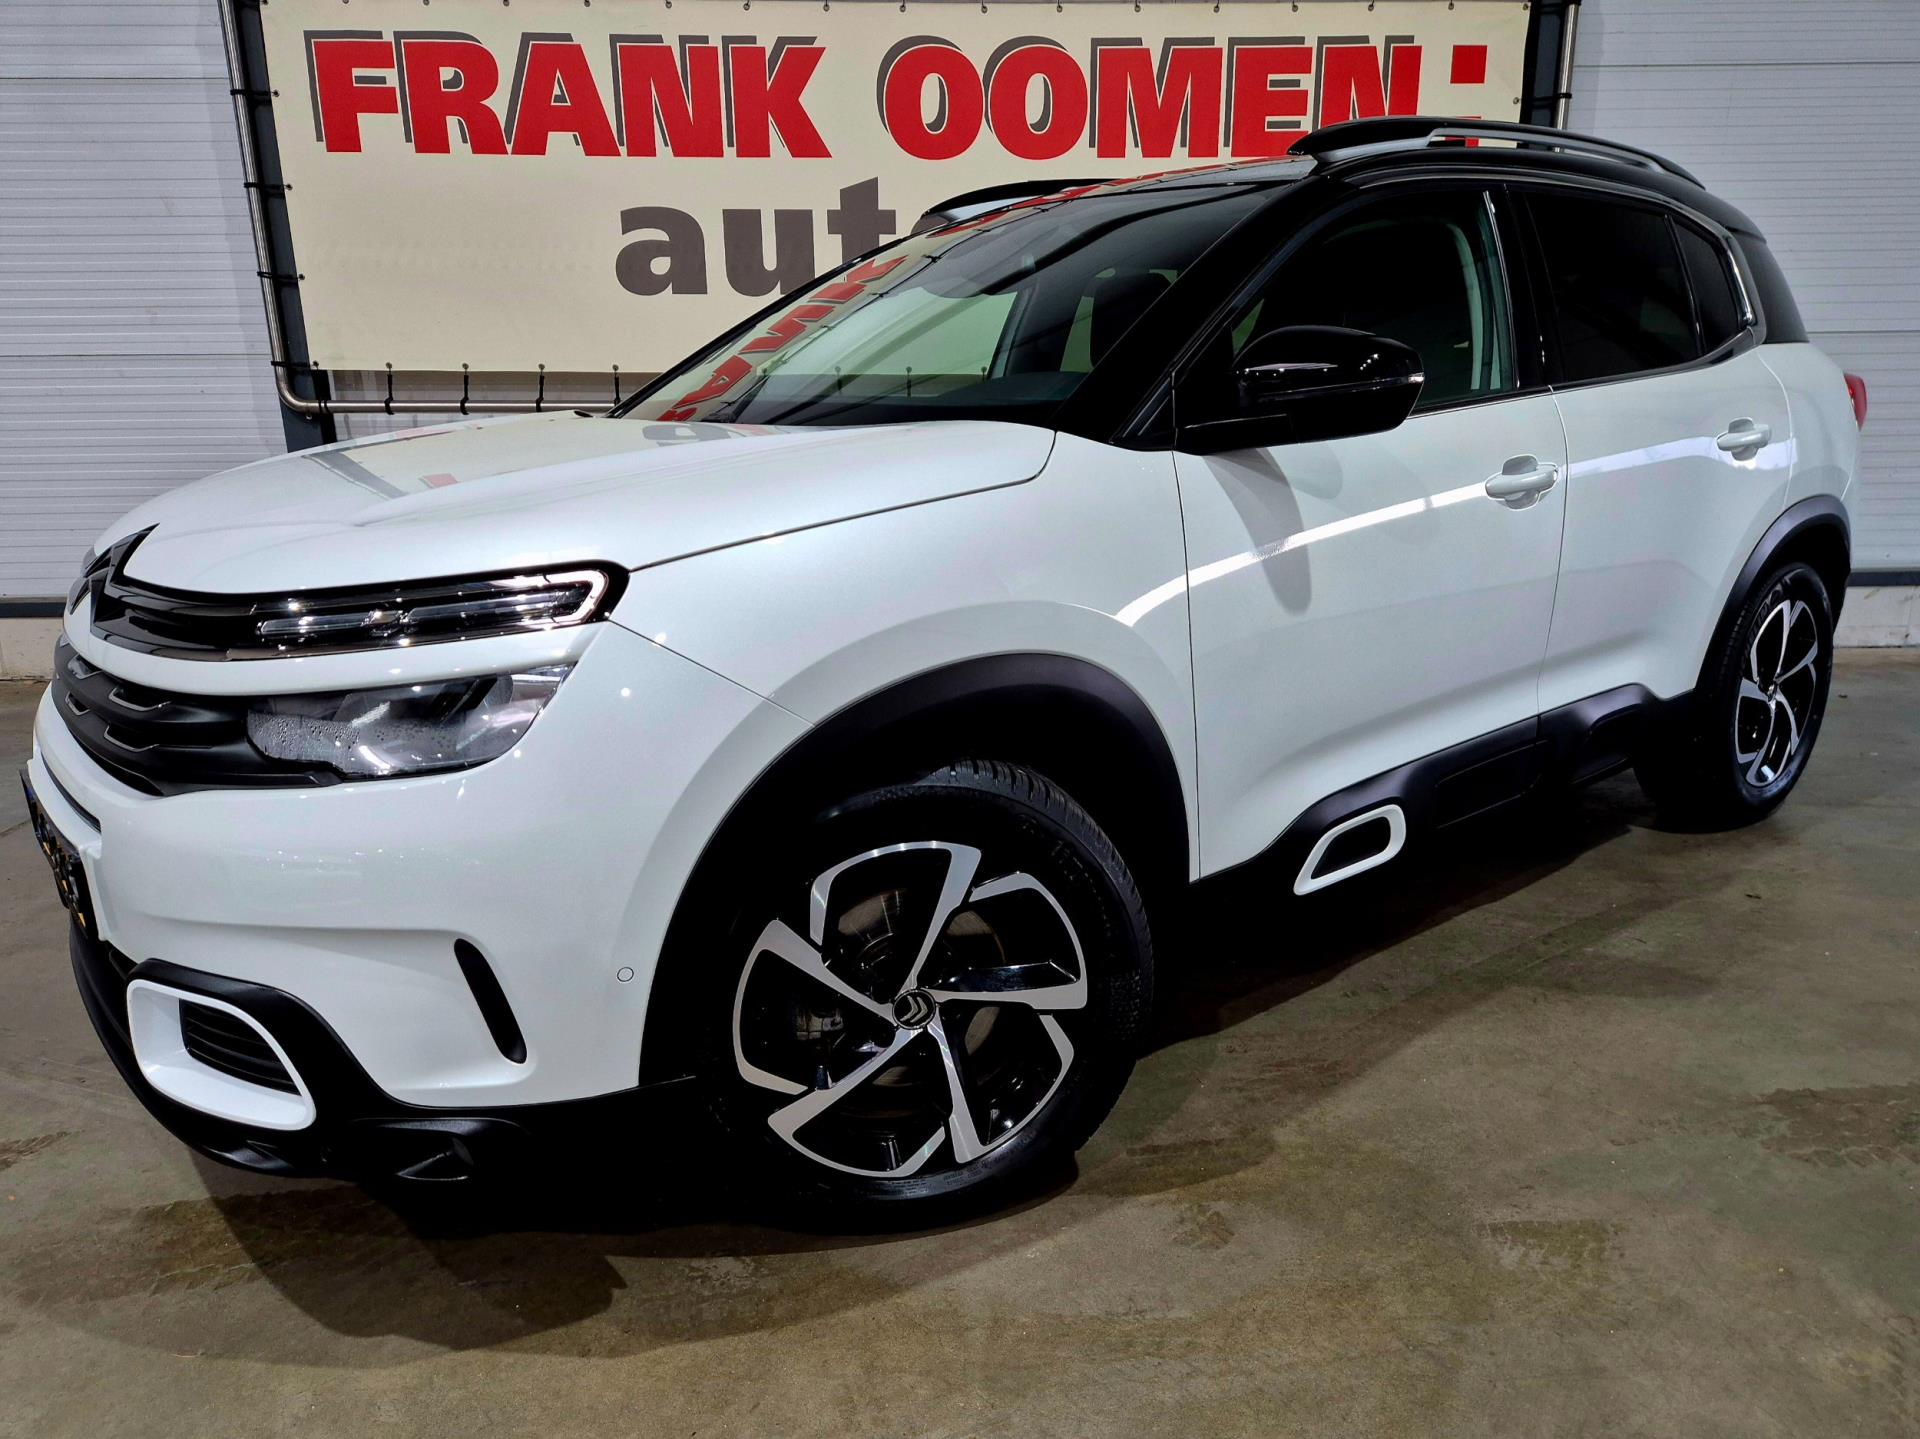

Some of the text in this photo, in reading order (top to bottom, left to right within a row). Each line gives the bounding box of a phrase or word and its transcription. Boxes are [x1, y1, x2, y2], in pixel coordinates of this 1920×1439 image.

[304, 30, 1422, 160] FRANK OOMEN
[615, 177, 946, 297] aut
